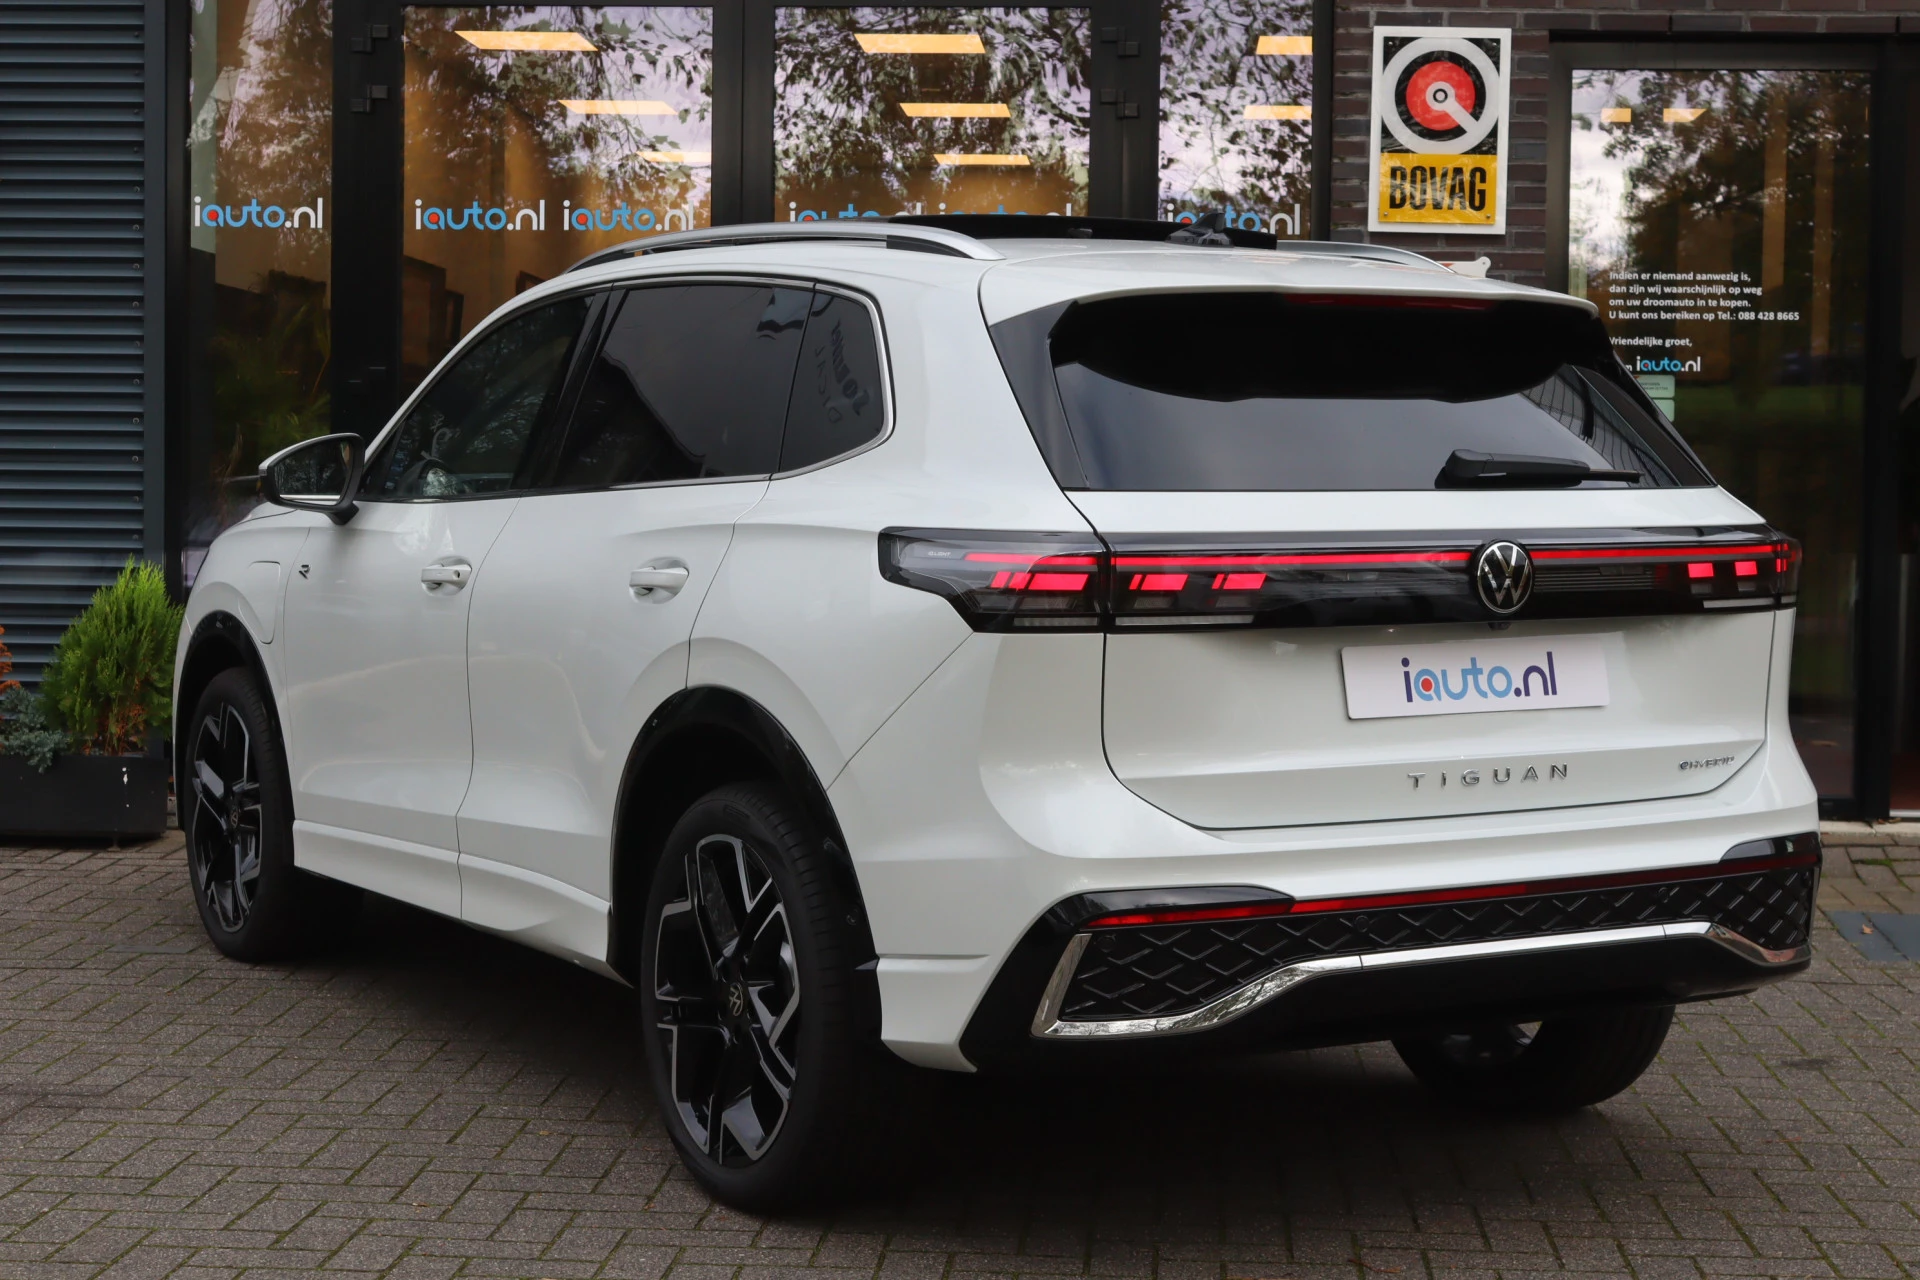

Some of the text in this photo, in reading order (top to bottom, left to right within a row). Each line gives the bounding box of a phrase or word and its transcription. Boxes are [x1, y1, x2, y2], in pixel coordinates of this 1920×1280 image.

[1389, 165, 1487, 211] BOVAG
[194, 195, 323, 229] iauto.nl
[415, 198, 694, 232] iauto.nl iauto.nl
[1609, 271, 1751, 282] Indien er niemand aanwezig is,
[1609, 284, 1763, 296] dan zijn wij waarschijnlijk op weg
[1643, 297, 1695, 307] droomauto
[1697, 298, 1706, 307] in
[1708, 299, 1718, 307] te
[1719, 298, 1752, 309] kopen.
[1609, 310, 1800, 322] U kunt ons bereiken op Tel.: 088 428 8665
[1609, 336, 1693, 348] Vriendelijke groet,
[1636, 355, 1701, 372] iauto.nl
[1401, 651, 1558, 703] iauto.nl
[1407, 762, 1568, 790] TIGUAN
